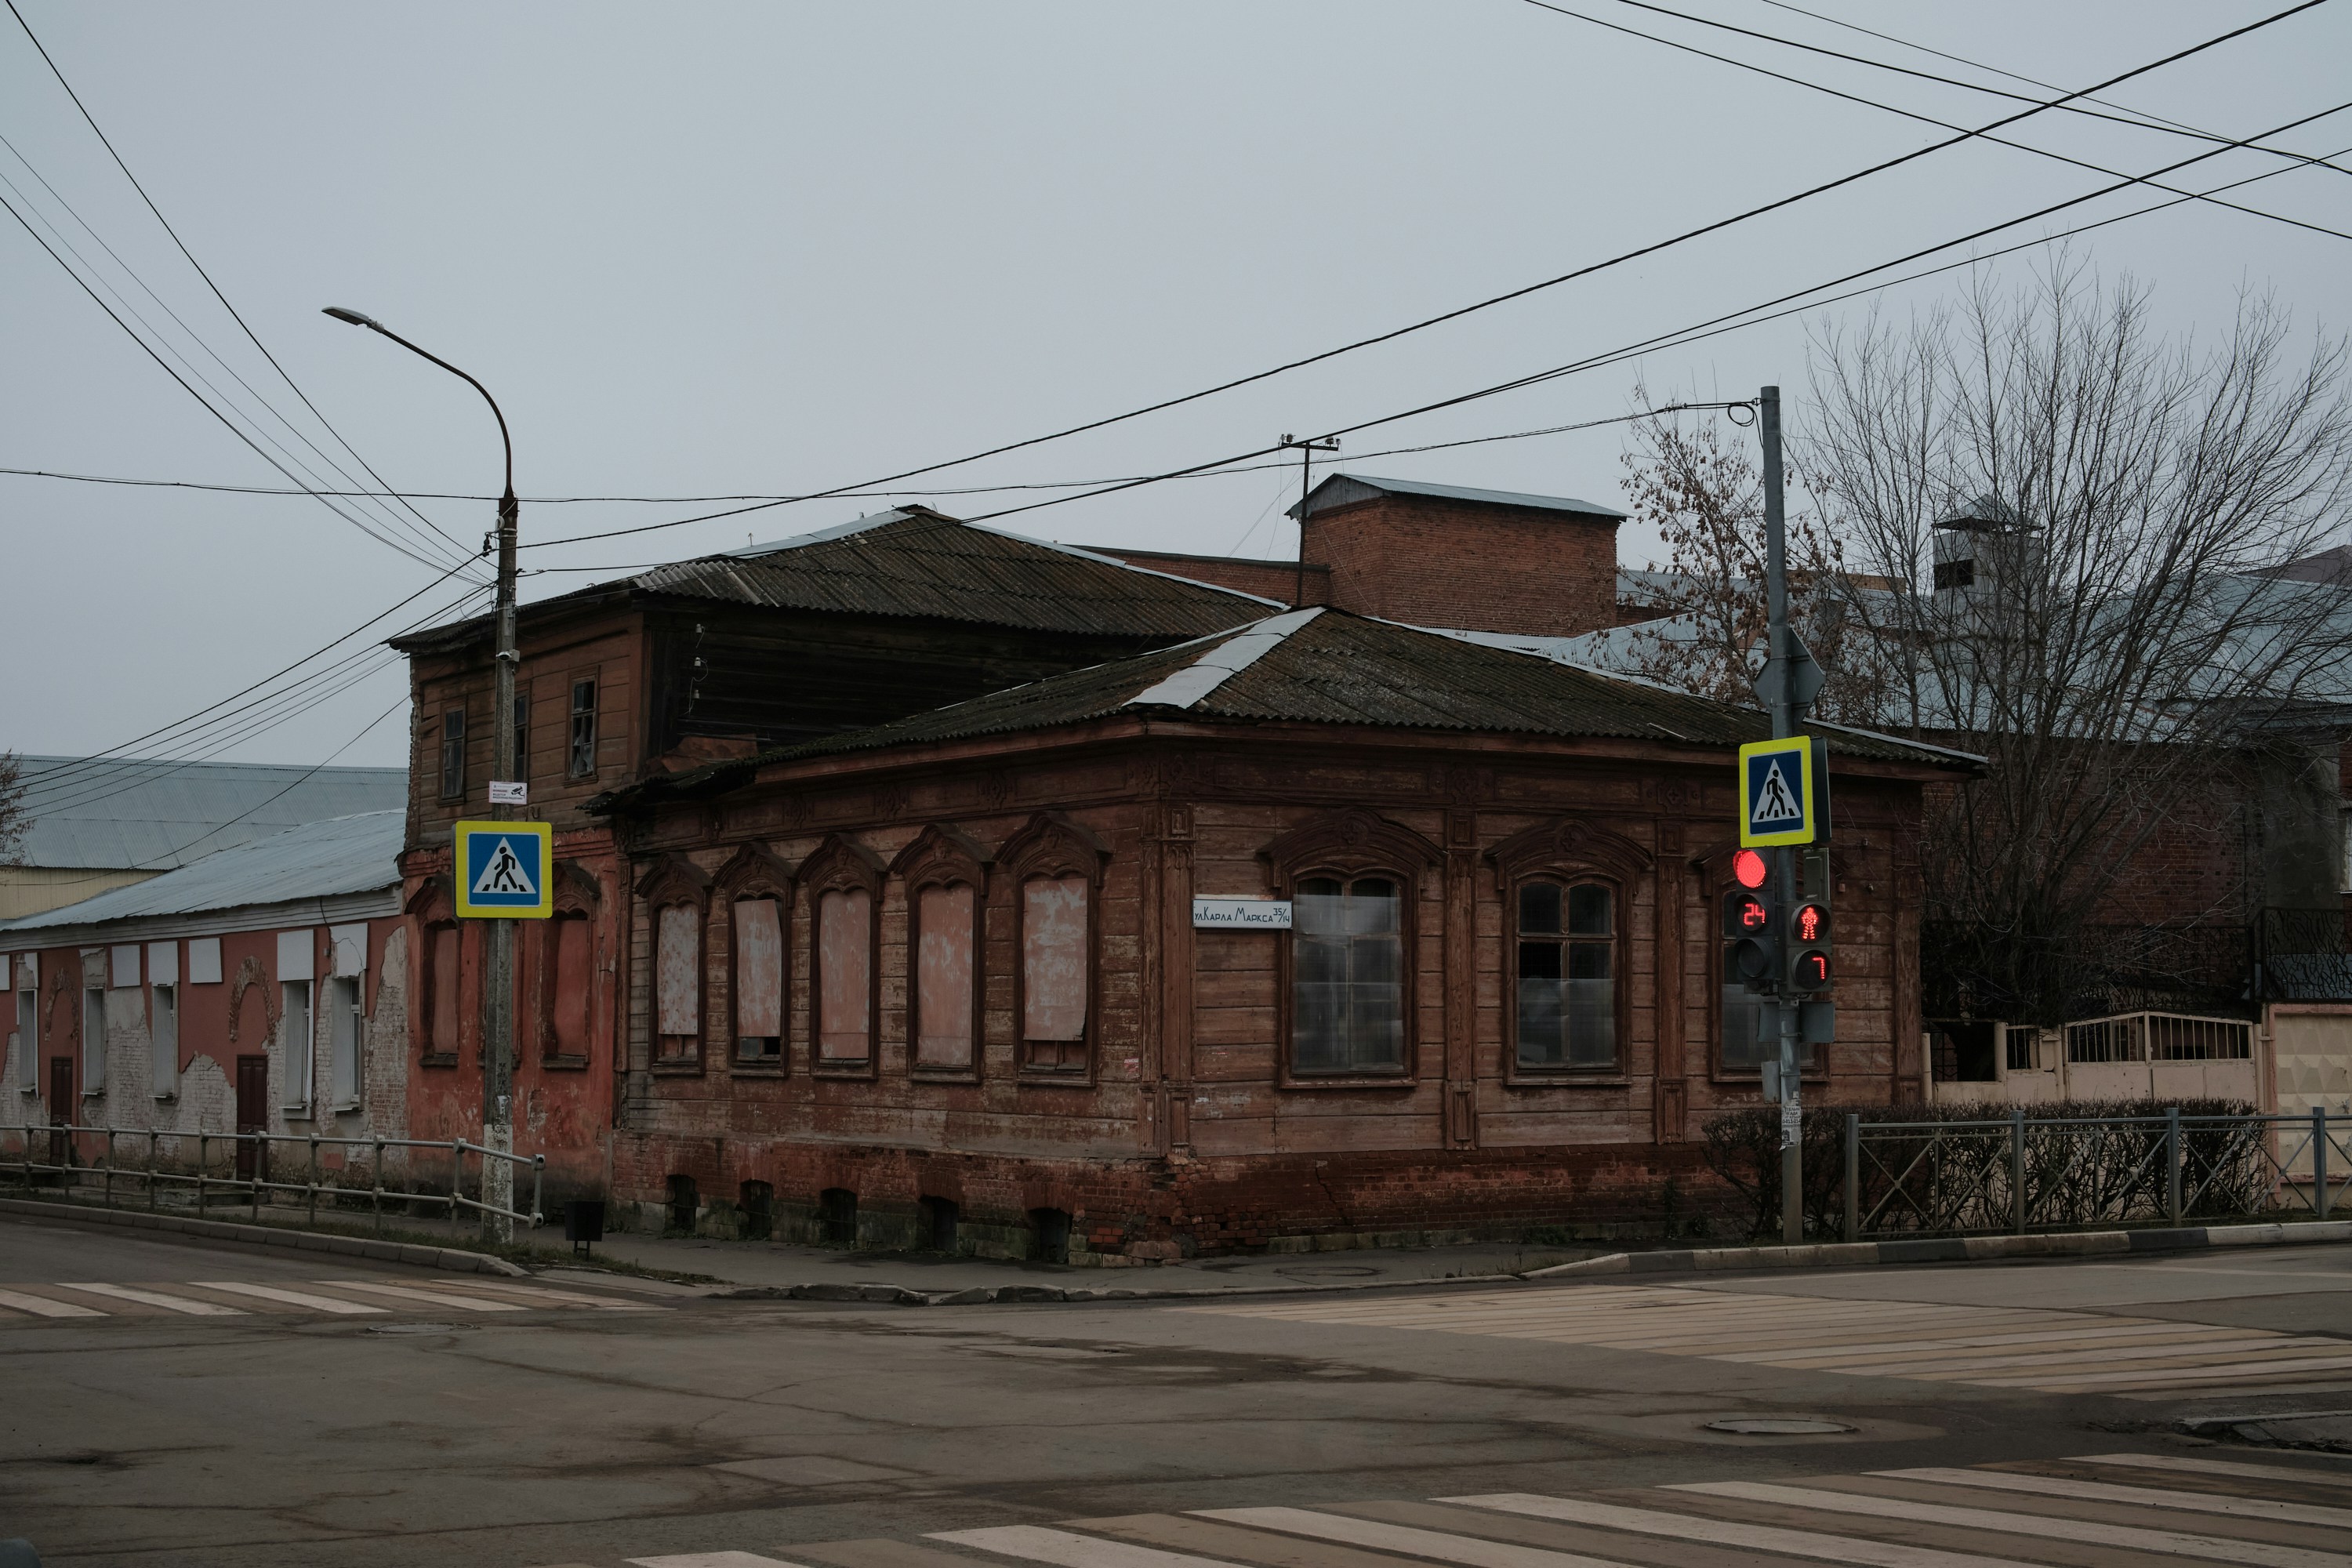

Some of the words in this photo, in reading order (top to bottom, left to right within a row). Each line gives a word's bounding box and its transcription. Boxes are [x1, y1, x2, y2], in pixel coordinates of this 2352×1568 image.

[1273, 907, 1290, 923] 35/14
[1743, 902, 1766, 926] 24
[1812, 956, 1826, 980] 7
